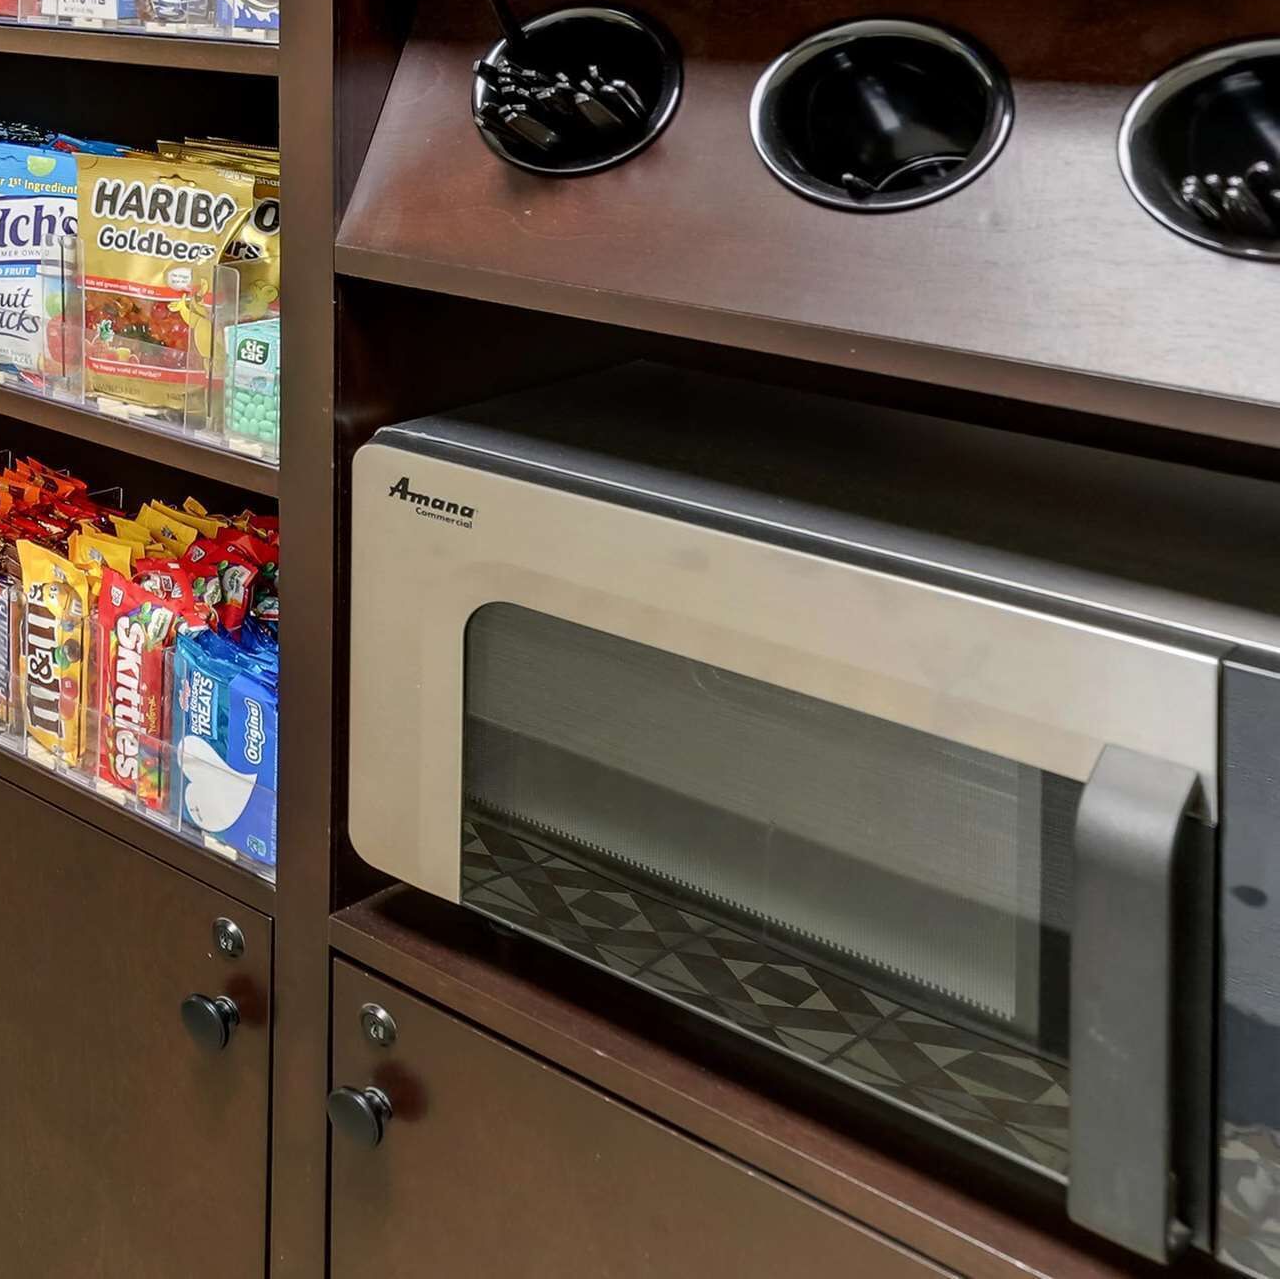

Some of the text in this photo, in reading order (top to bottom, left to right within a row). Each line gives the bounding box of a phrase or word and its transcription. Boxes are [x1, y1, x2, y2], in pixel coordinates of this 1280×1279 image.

[8, 176, 22, 188] 1st
[24, 179, 78, 194] Ingredient
[93, 179, 237, 234] HARIBO
[5, 266, 31, 276] FRUIT
[240, 349, 264, 363] tac
[245, 340, 265, 353] tic
[388, 476, 477, 519] Amana
[415, 506, 474, 529] Commercial
[114, 615, 146, 782] Skittles
[190, 670, 202, 735] RICE KRISPIES
[197, 676, 214, 736] TREATS
[245, 698, 262, 761] Original
